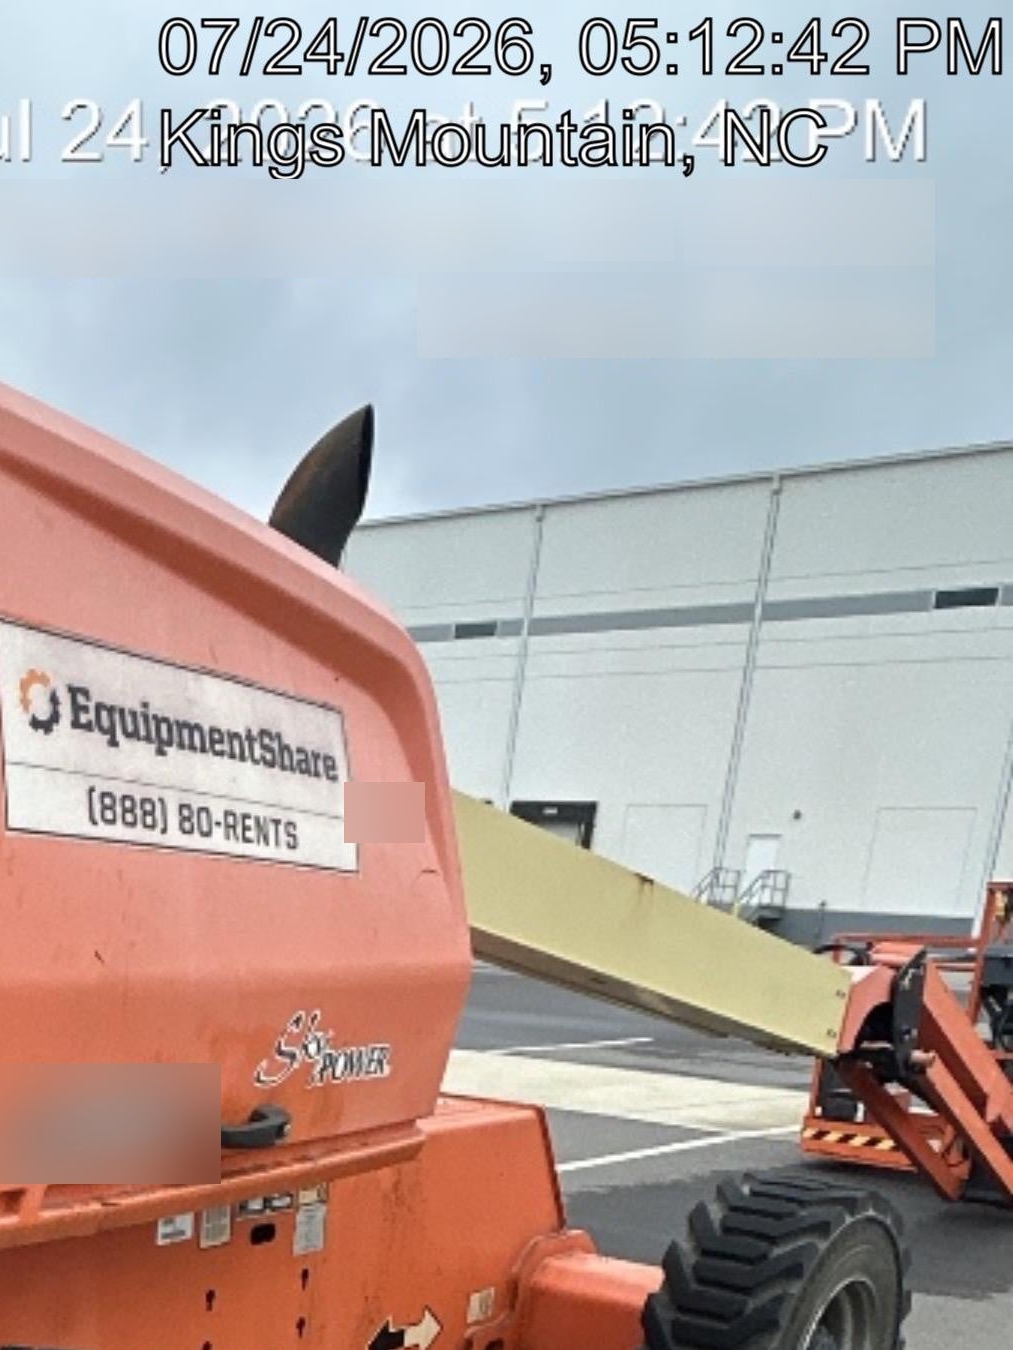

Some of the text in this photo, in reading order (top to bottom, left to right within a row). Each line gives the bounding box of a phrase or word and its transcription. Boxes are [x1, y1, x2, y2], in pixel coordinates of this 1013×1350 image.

[68, 684, 339, 782] EquipmentShare
[88, 786, 299, 850] (888) 80-RENTS
